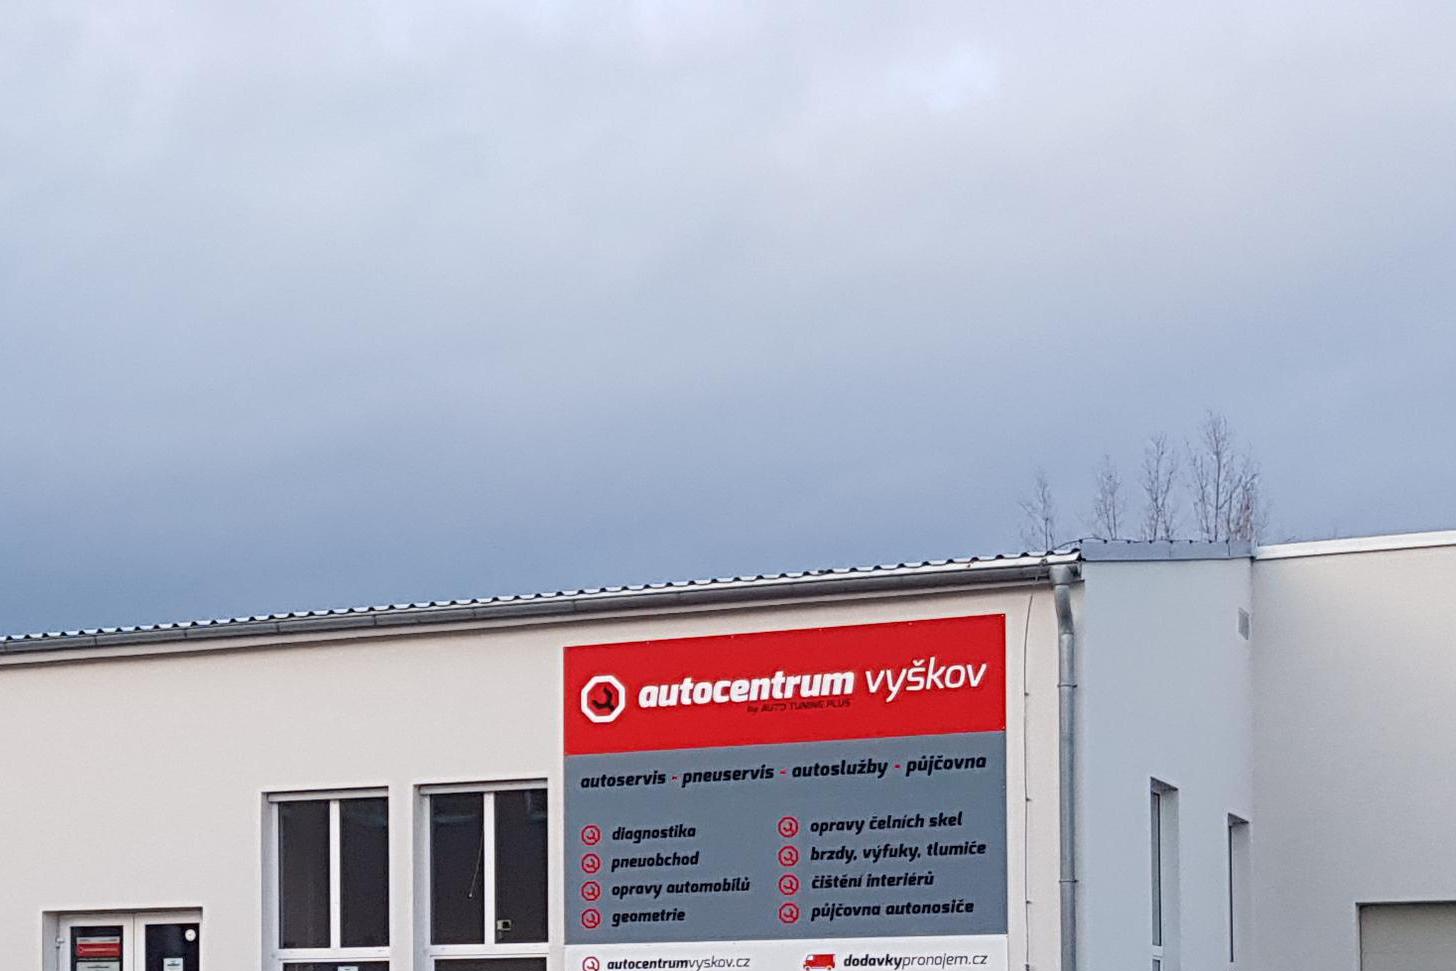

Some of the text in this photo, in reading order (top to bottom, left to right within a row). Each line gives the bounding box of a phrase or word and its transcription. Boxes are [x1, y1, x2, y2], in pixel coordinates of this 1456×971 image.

[639, 656, 987, 708] autocentrum vyškov
[580, 770, 666, 788] autoservis
[681, 764, 774, 788] pneuservis
[792, 758, 888, 779] autoslužby
[905, 755, 987, 777] půjčovna
[612, 824, 696, 844] diagnostika
[810, 811, 963, 836] opravy čelních skel
[611, 850, 700, 872] pneuobchod
[810, 841, 987, 864] brzdy, výfuky, tlumiče
[611, 877, 751, 900] opravy automobilů
[866, 871, 934, 887] interiérů
[611, 908, 686, 927] geometrie
[811, 898, 974, 921] půjčovna autonosiče
[607, 955, 751, 971] autocentrumvyskov.cz
[843, 953, 988, 970] dodavkypronajem.cz
